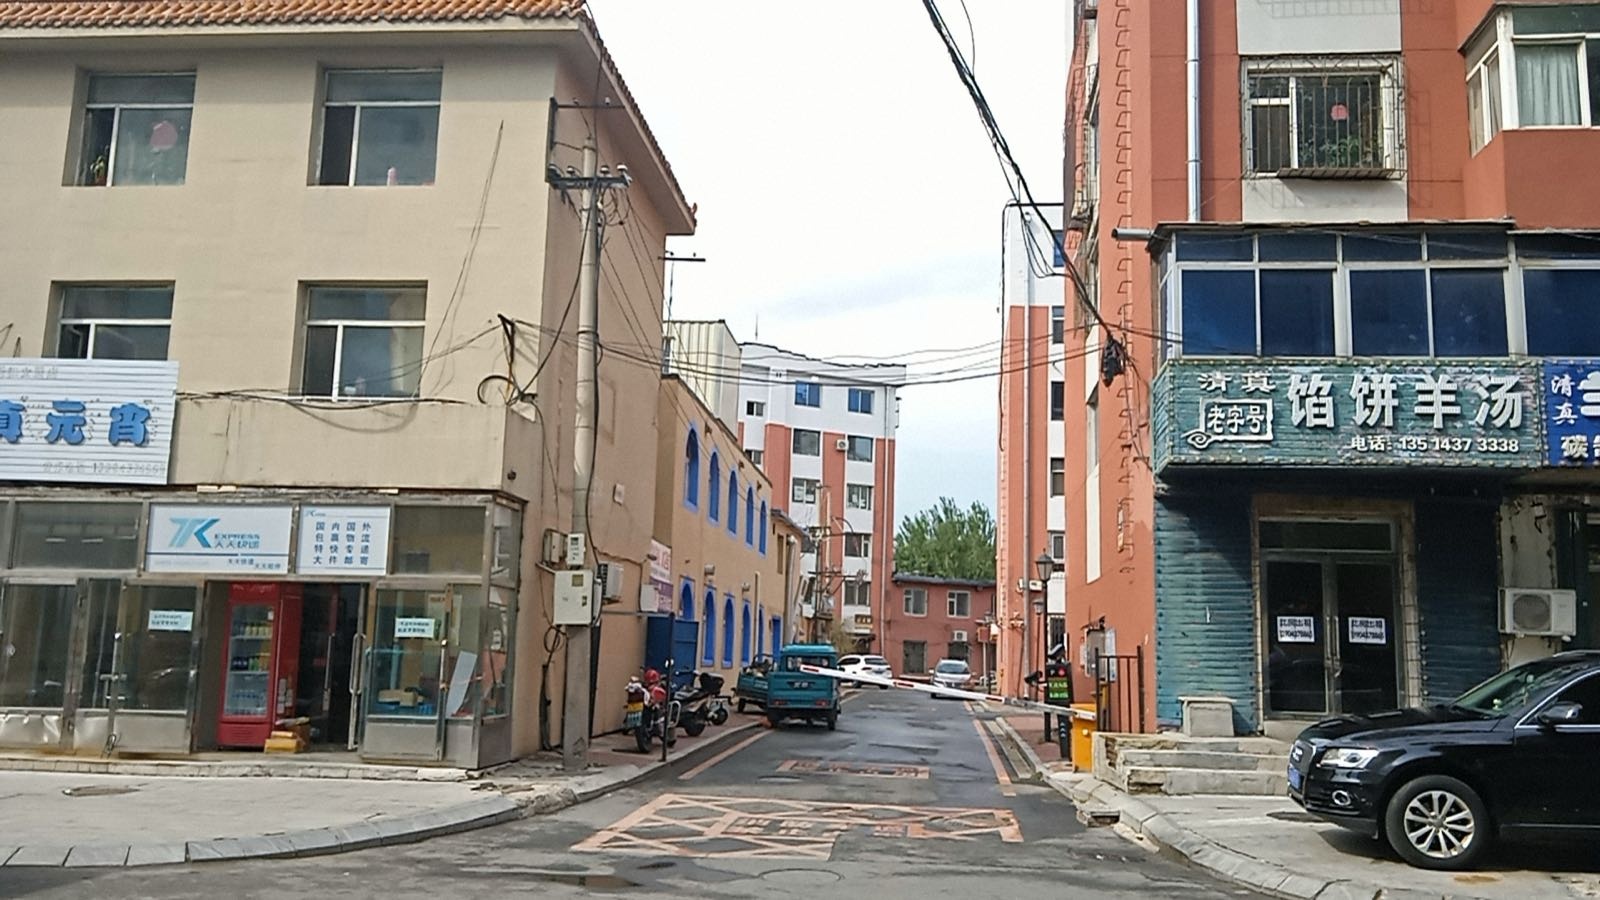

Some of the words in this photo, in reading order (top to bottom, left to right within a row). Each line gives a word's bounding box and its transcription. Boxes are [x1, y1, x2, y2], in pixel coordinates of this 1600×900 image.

[1197, 373, 1275, 391] 清真
[1287, 373, 1522, 429] 馅饼羊汤
[1551, 373, 1578, 425] 清真
[1206, 404, 1265, 435] 老字号
[1350, 436, 1392, 452] 电话:
[1399, 437, 1427, 451] 135
[1430, 437, 1471, 452] 1437
[1477, 437, 1519, 452] 3338
[316, 522, 371, 531] 国内国外
[315, 532, 370, 542] 包裹物流
[314, 544, 369, 554] 特快专递
[313, 555, 368, 565] 大件邮寄
